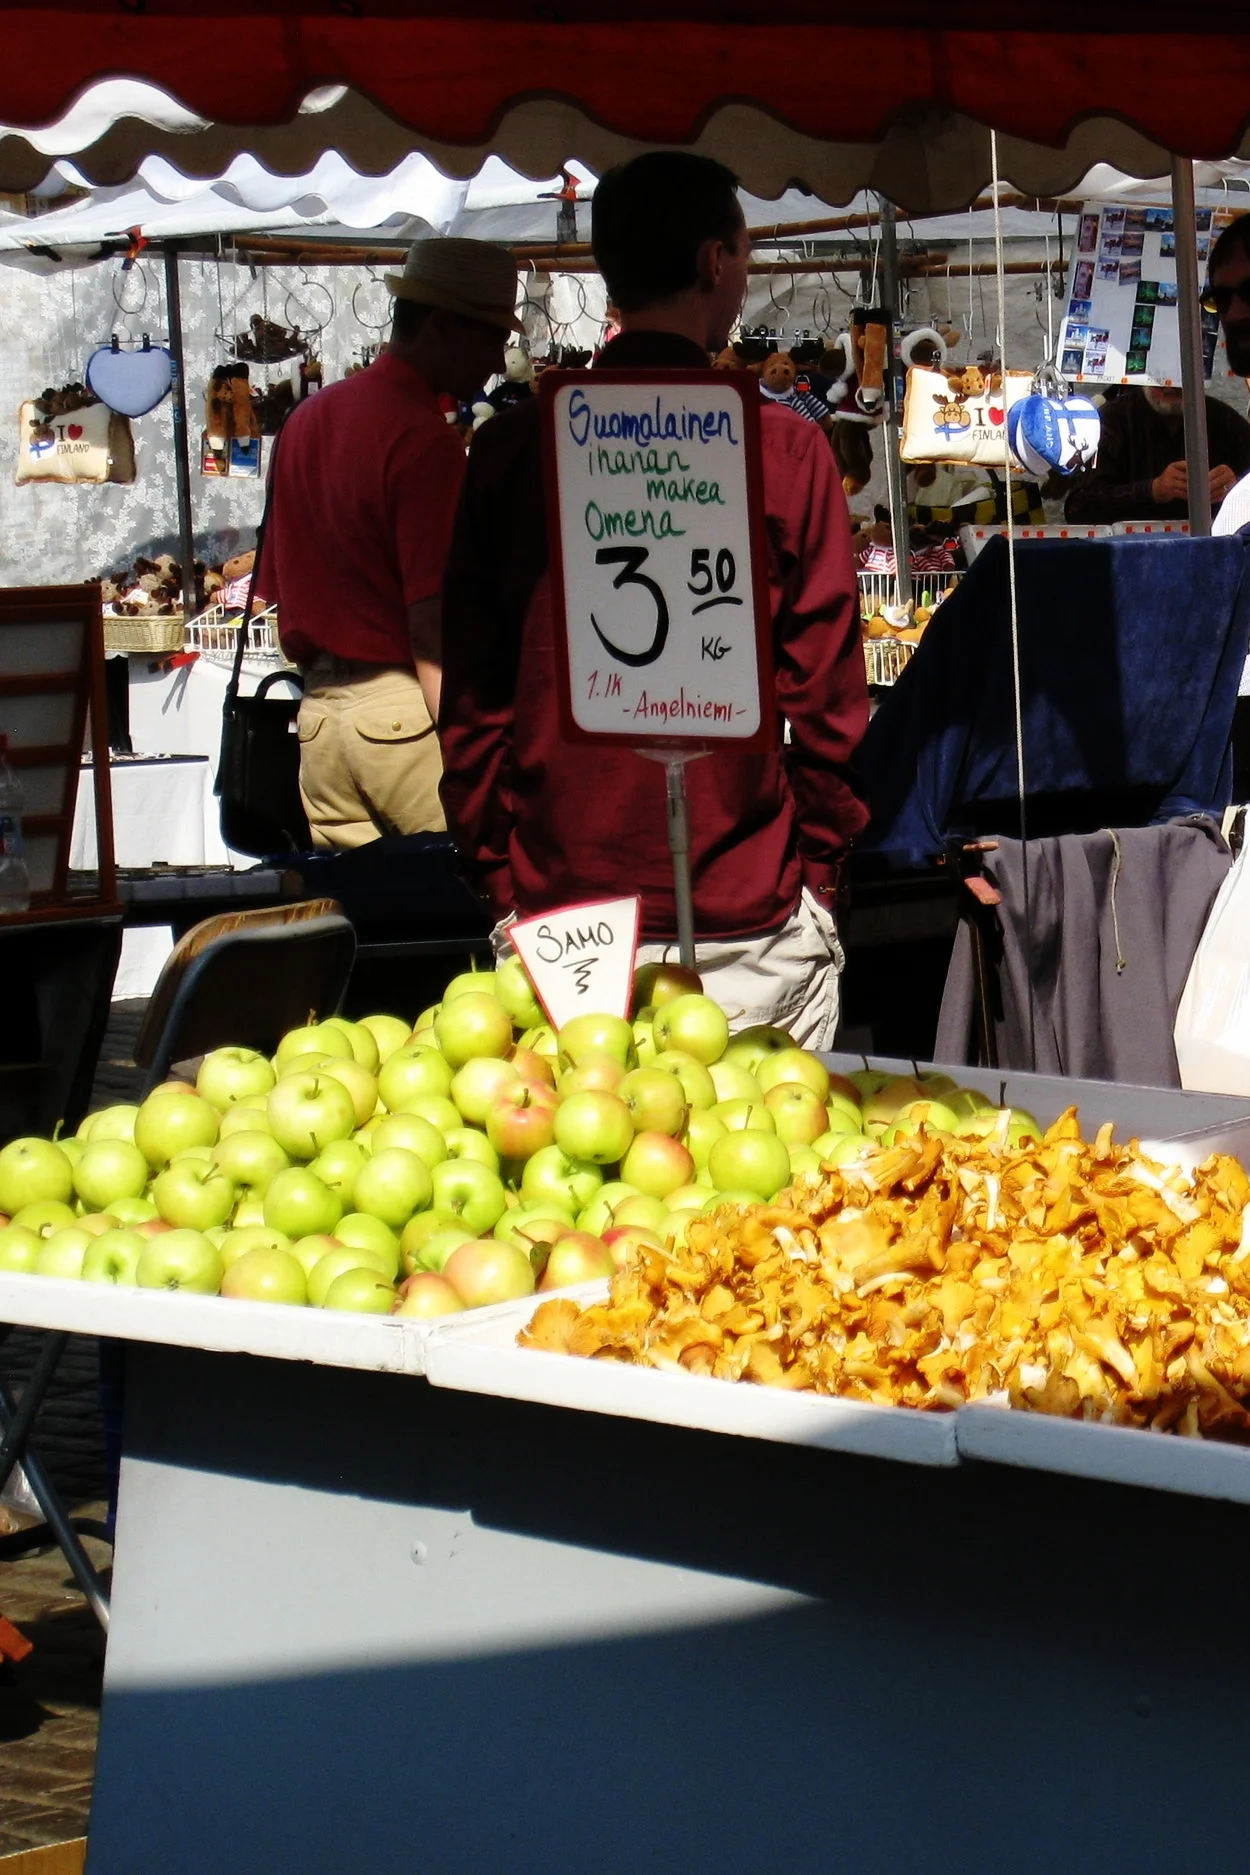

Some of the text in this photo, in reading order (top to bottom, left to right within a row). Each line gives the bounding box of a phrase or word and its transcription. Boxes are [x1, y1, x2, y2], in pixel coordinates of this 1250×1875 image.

[568, 389, 738, 447] Suomalainen
[588, 442, 690, 476] ihanan
[646, 477, 726, 506] makea
[584, 500, 687, 541] Omena
[590, 546, 737, 668] 3 50
[701, 636, 732, 662] KG
[536, 921, 614, 963] SAMO
